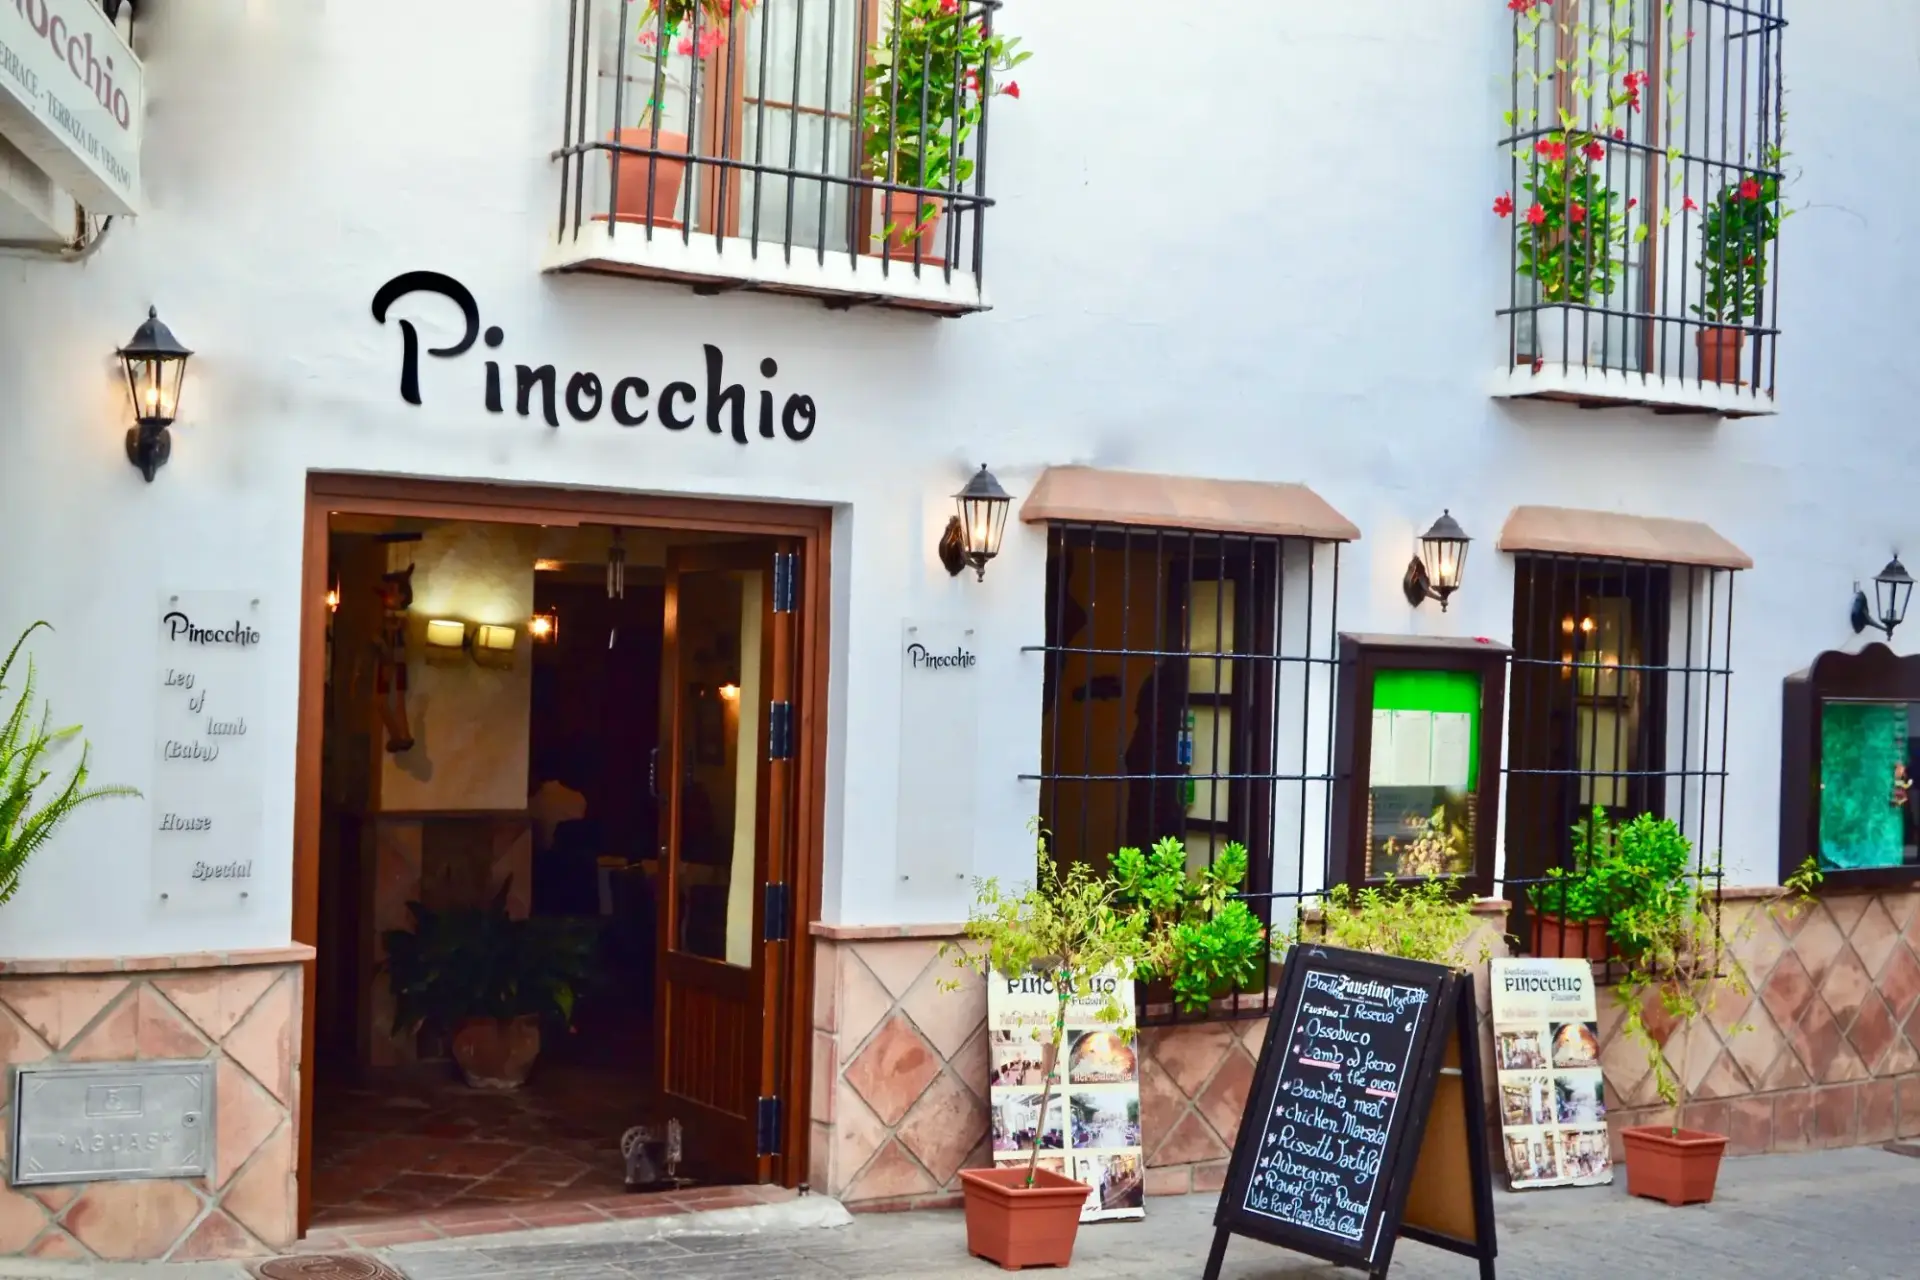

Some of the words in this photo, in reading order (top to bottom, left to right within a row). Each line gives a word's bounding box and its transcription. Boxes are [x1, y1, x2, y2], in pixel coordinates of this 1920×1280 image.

[372, 270, 816, 444] Pinocchio
[163, 611, 260, 645] Pinocchio
[908, 643, 976, 669] Pinocchio
[164, 668, 195, 689] Leg
[189, 689, 206, 713] of
[207, 716, 247, 735] lamb
[164, 739, 219, 761] (Baby)
[158, 813, 212, 830] House
[192, 860, 252, 881] Special
[1505, 977, 1582, 992] PINOCCHIO
[1305, 1018, 1371, 1045] Ossobuco
[1348, 1069, 1366, 1087] the
[1370, 1080, 1397, 1093] oven
[1251, 1188, 1268, 1209] We
